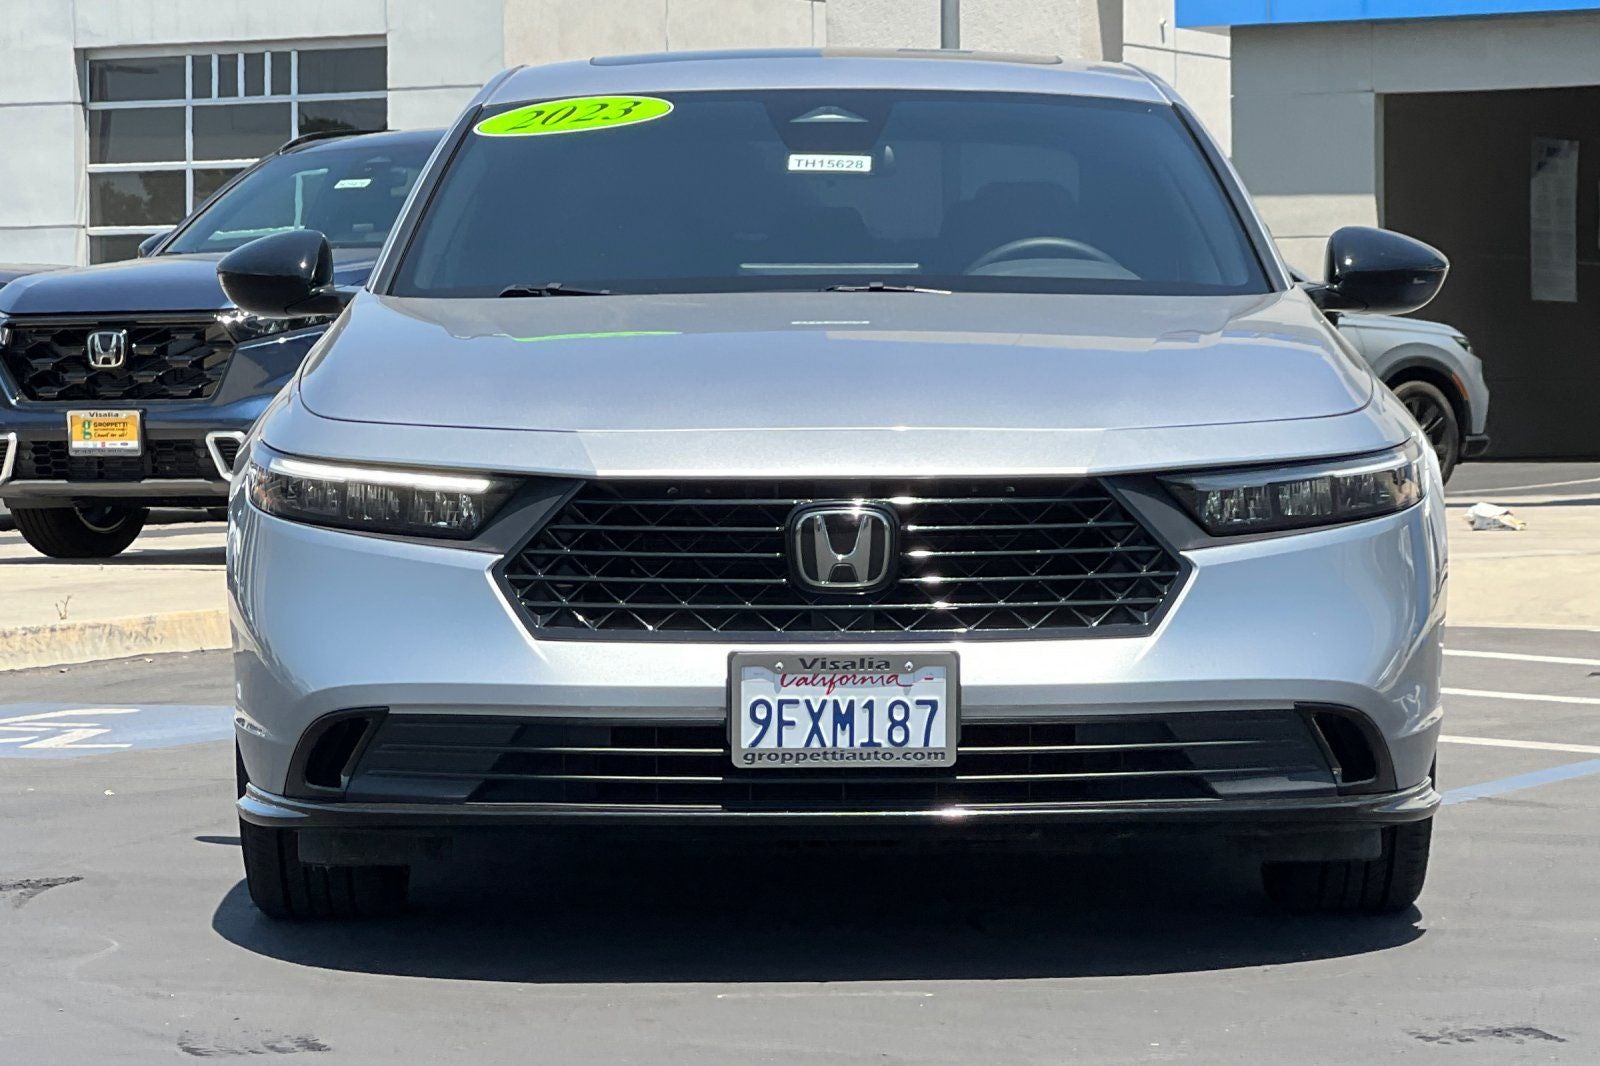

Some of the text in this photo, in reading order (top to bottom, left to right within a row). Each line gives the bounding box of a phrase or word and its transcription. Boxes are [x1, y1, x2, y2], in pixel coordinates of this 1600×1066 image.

[504, 101, 642, 132] 2023
[794, 158, 864, 169] TH15628
[799, 657, 891, 670] Visalia
[749, 698, 939, 748] 9FXM187
[743, 749, 946, 765] groppettiauto.com
